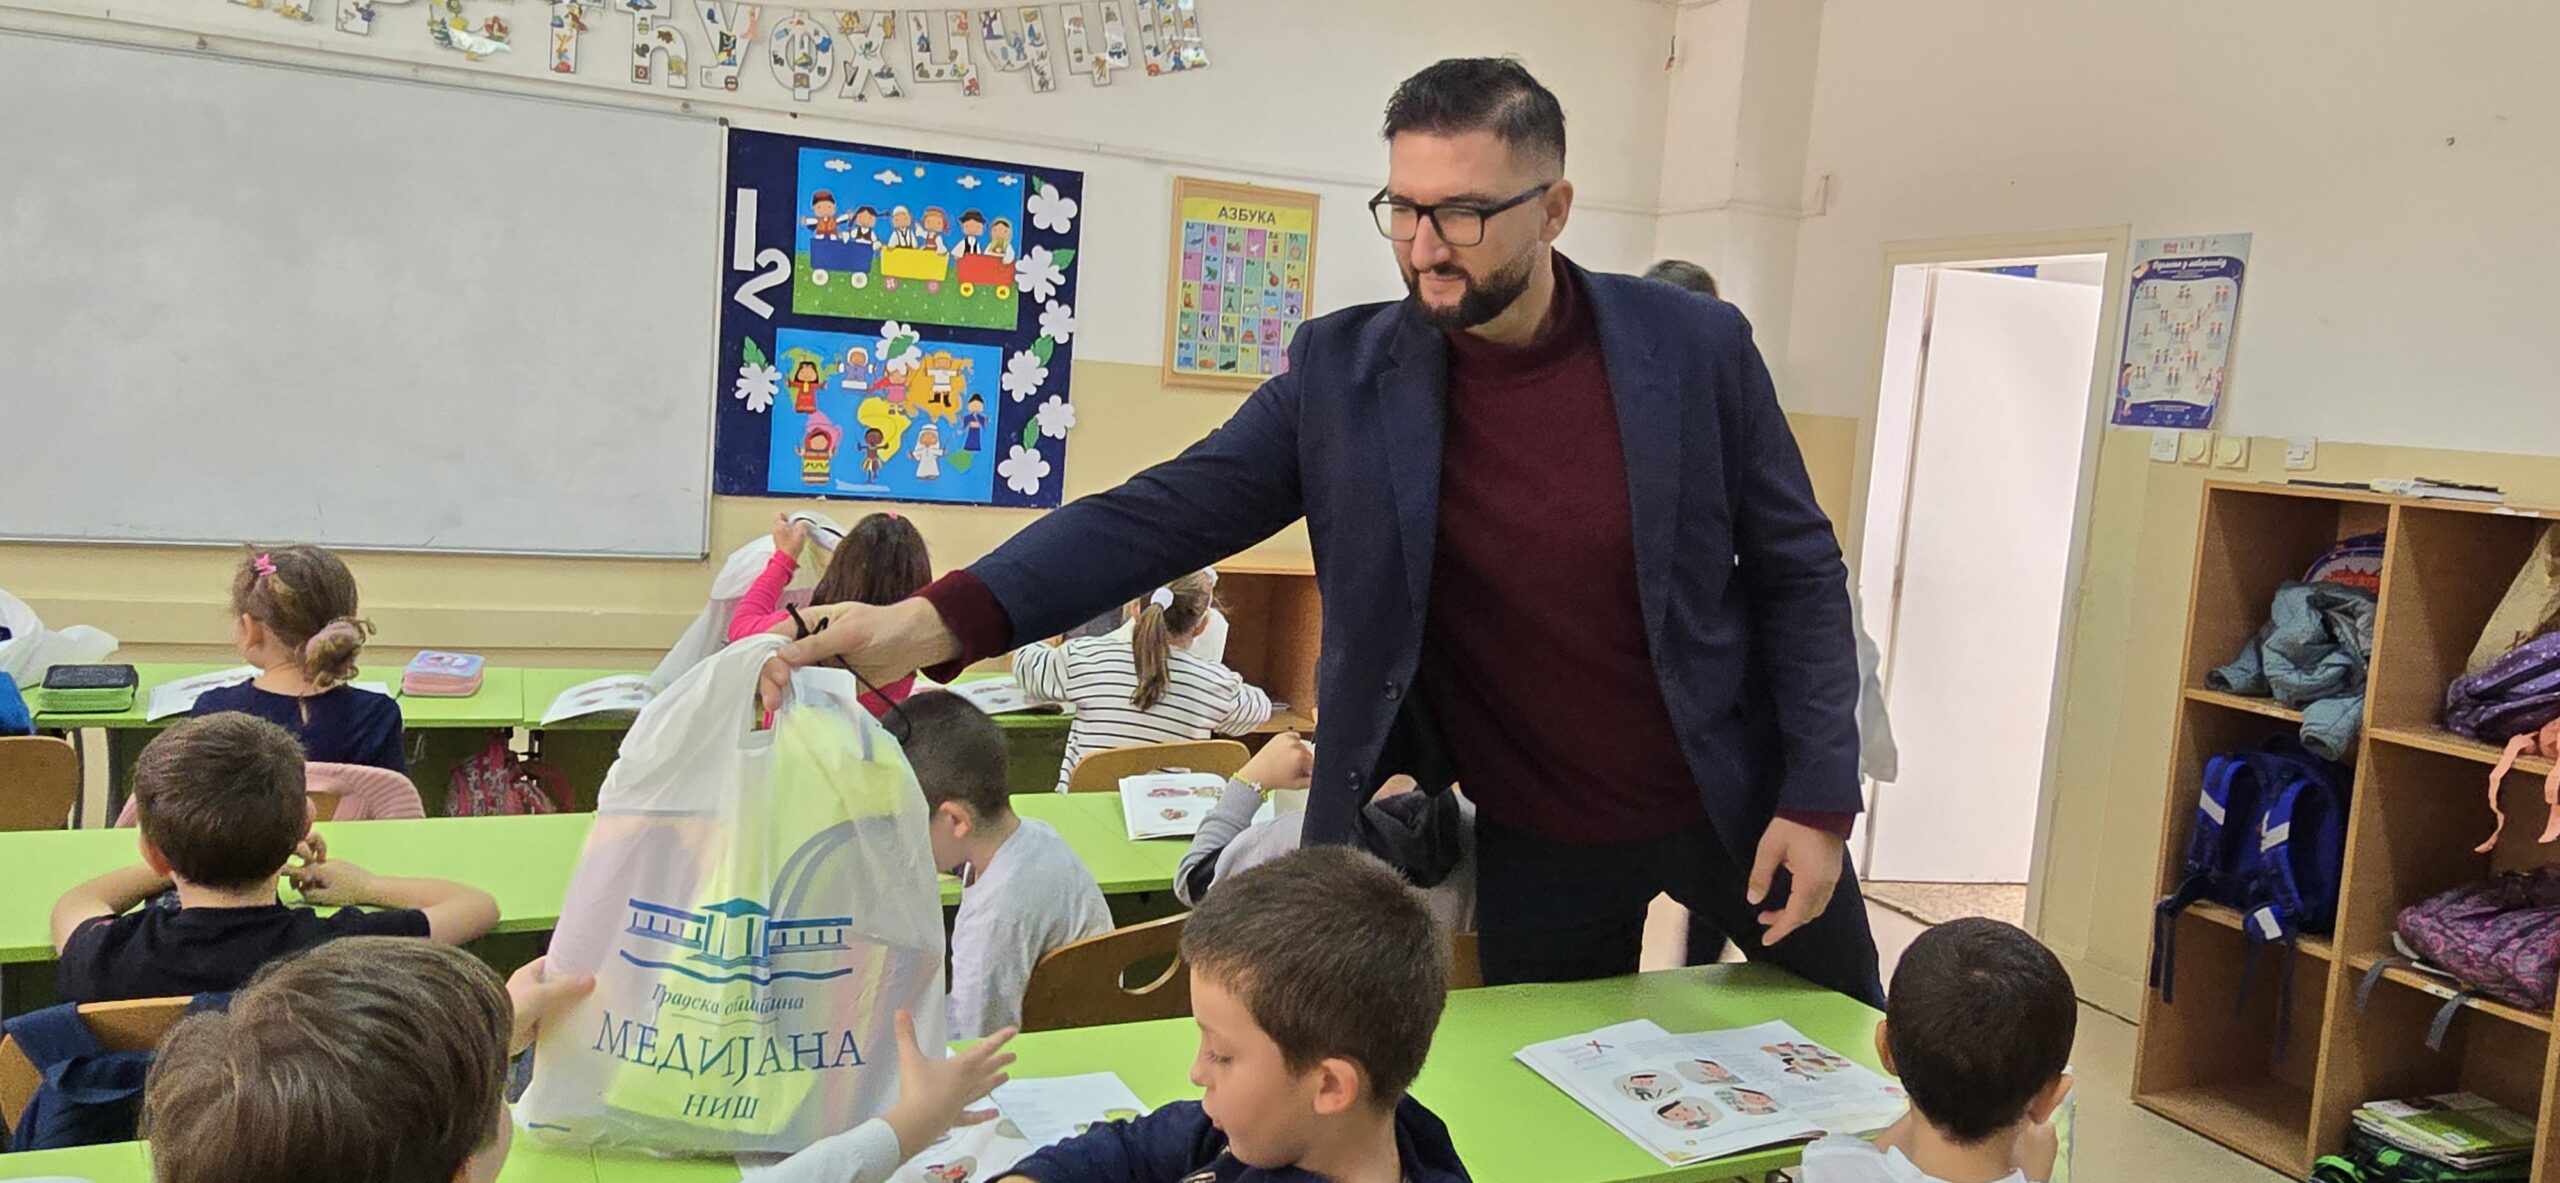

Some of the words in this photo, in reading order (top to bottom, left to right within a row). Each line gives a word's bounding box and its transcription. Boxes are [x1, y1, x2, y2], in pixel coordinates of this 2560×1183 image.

[1217, 205, 1277, 225] АЗБУКА
[651, 983, 720, 1014] Градска
[591, 1009, 866, 1087] МЕДИЈАНА
[682, 1093, 760, 1120] НИШ
